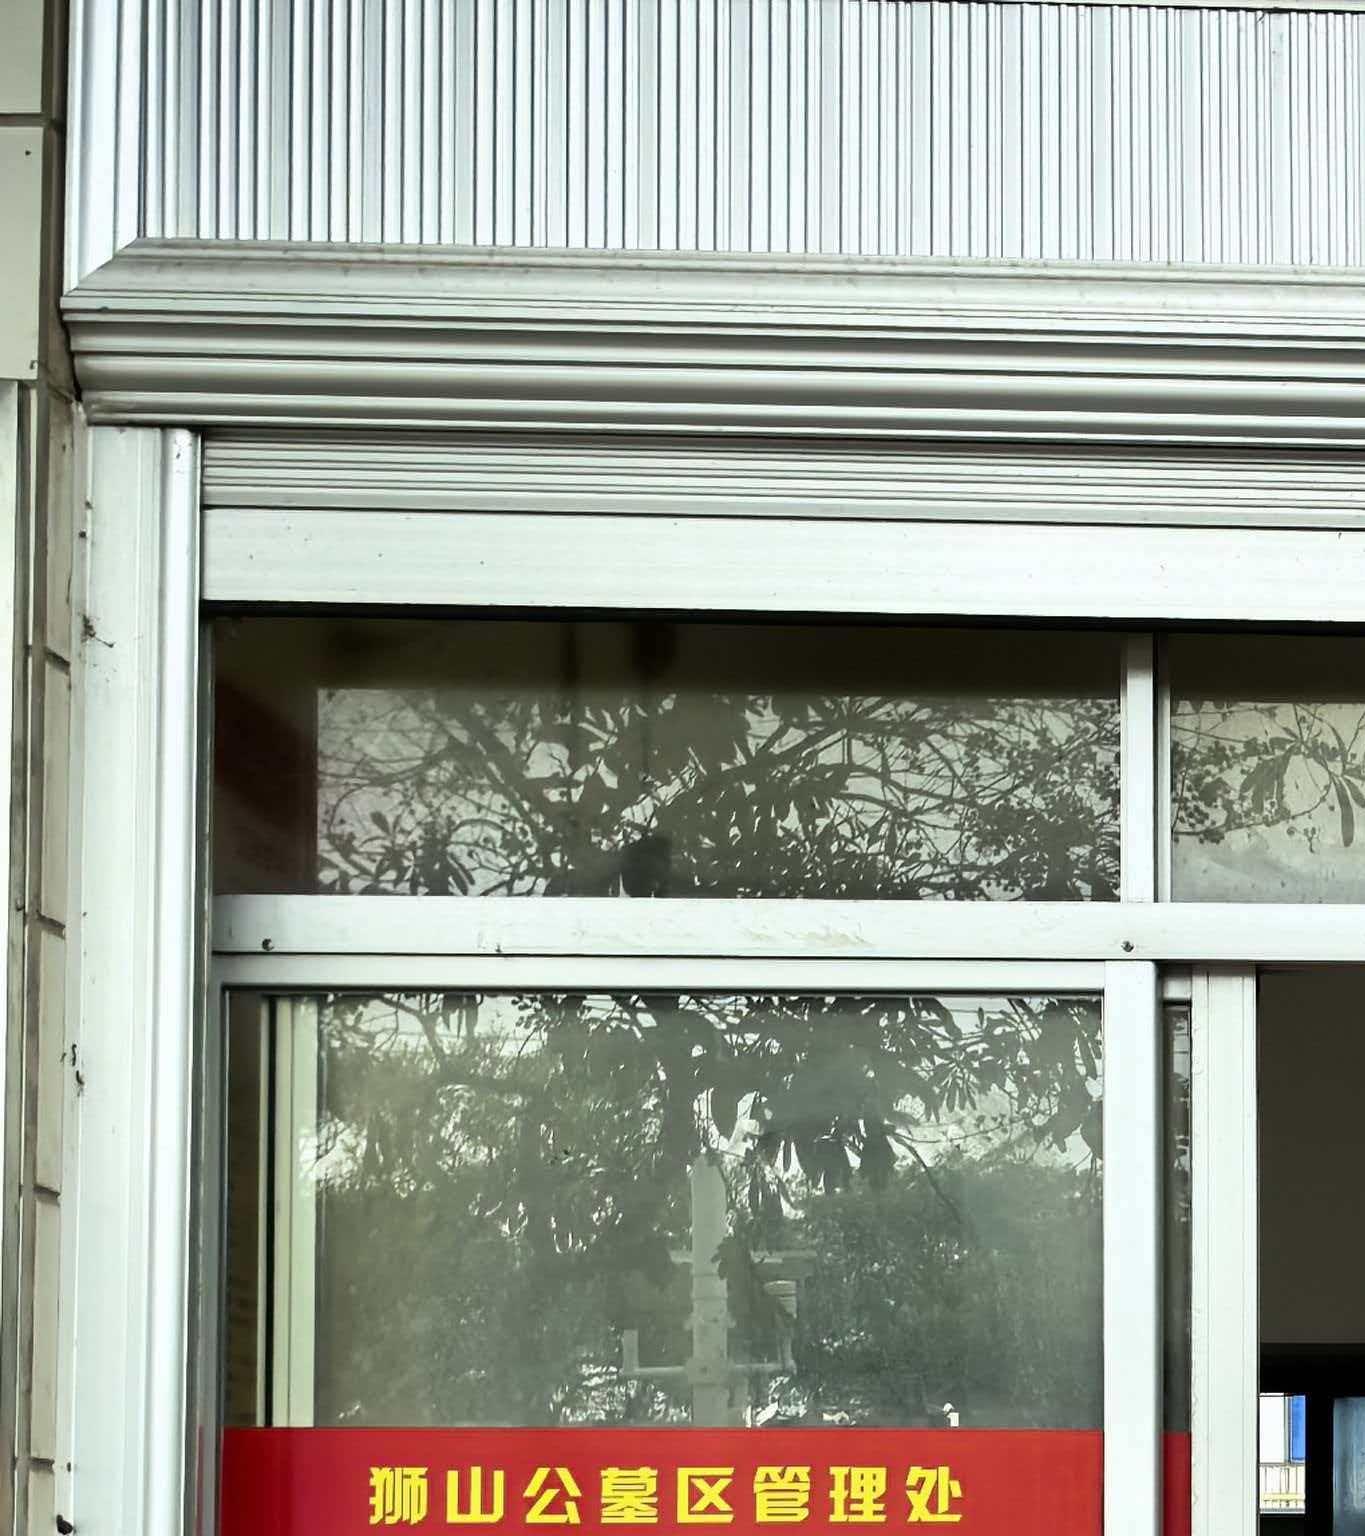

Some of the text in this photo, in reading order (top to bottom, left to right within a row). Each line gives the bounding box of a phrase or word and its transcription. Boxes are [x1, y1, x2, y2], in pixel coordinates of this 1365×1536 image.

[368, 1464, 963, 1526] 狮山公墓区管理处
